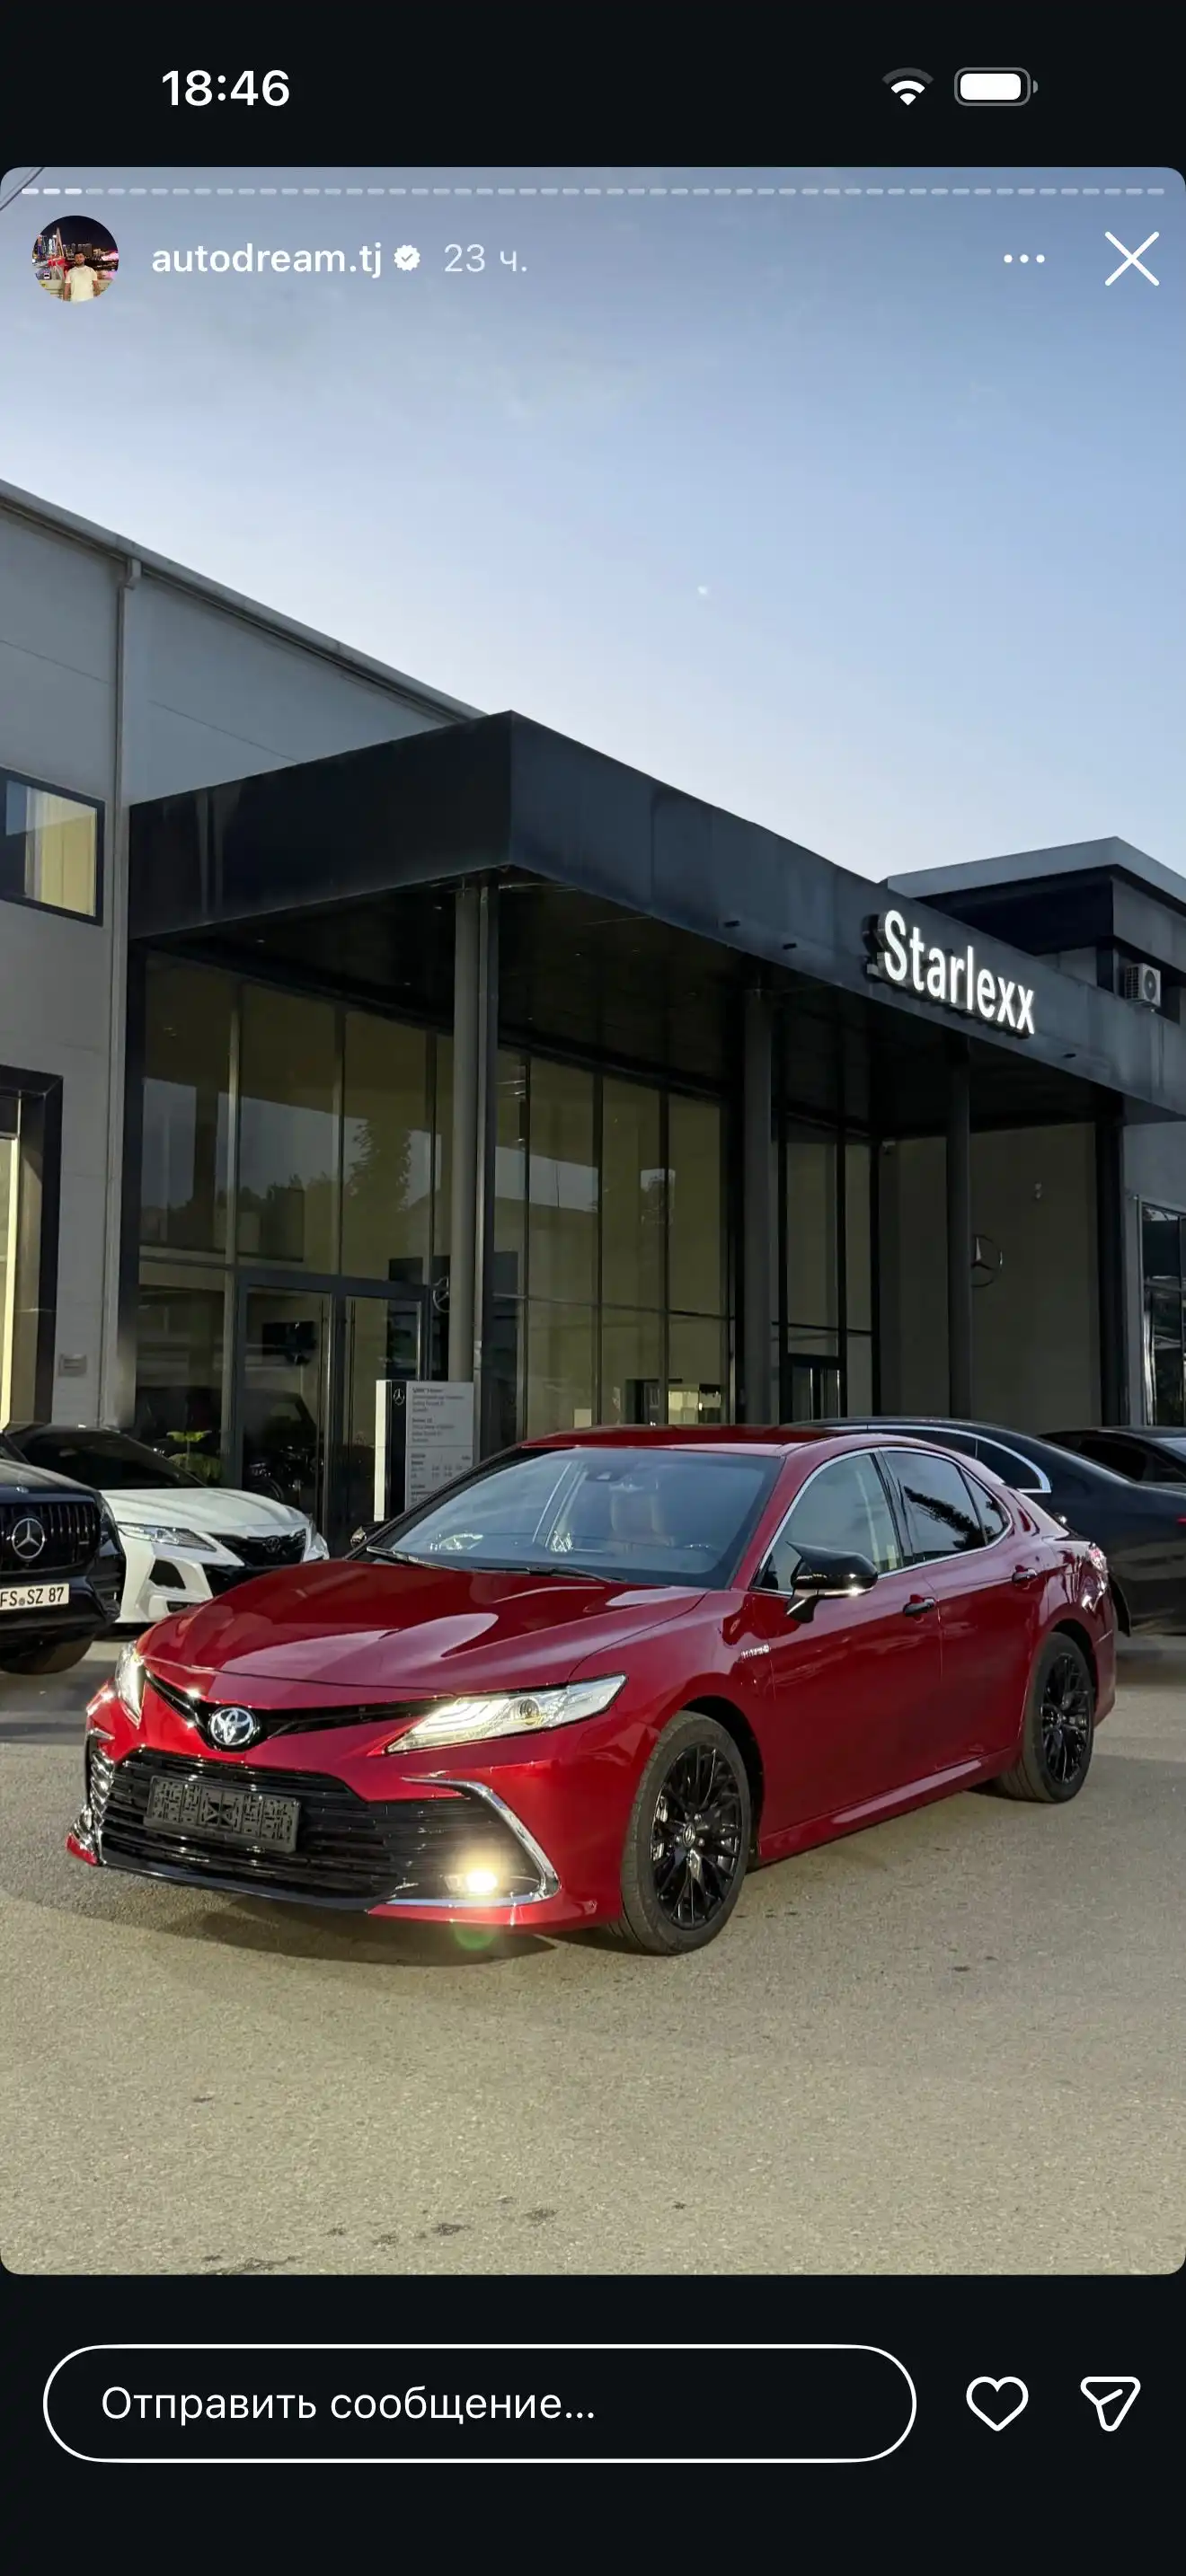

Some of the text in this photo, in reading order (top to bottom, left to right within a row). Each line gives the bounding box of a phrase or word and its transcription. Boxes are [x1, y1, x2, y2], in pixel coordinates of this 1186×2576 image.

[884, 909, 1035, 1035] Starlexx
[0, 1586, 65, 1608] FS SZ 87
